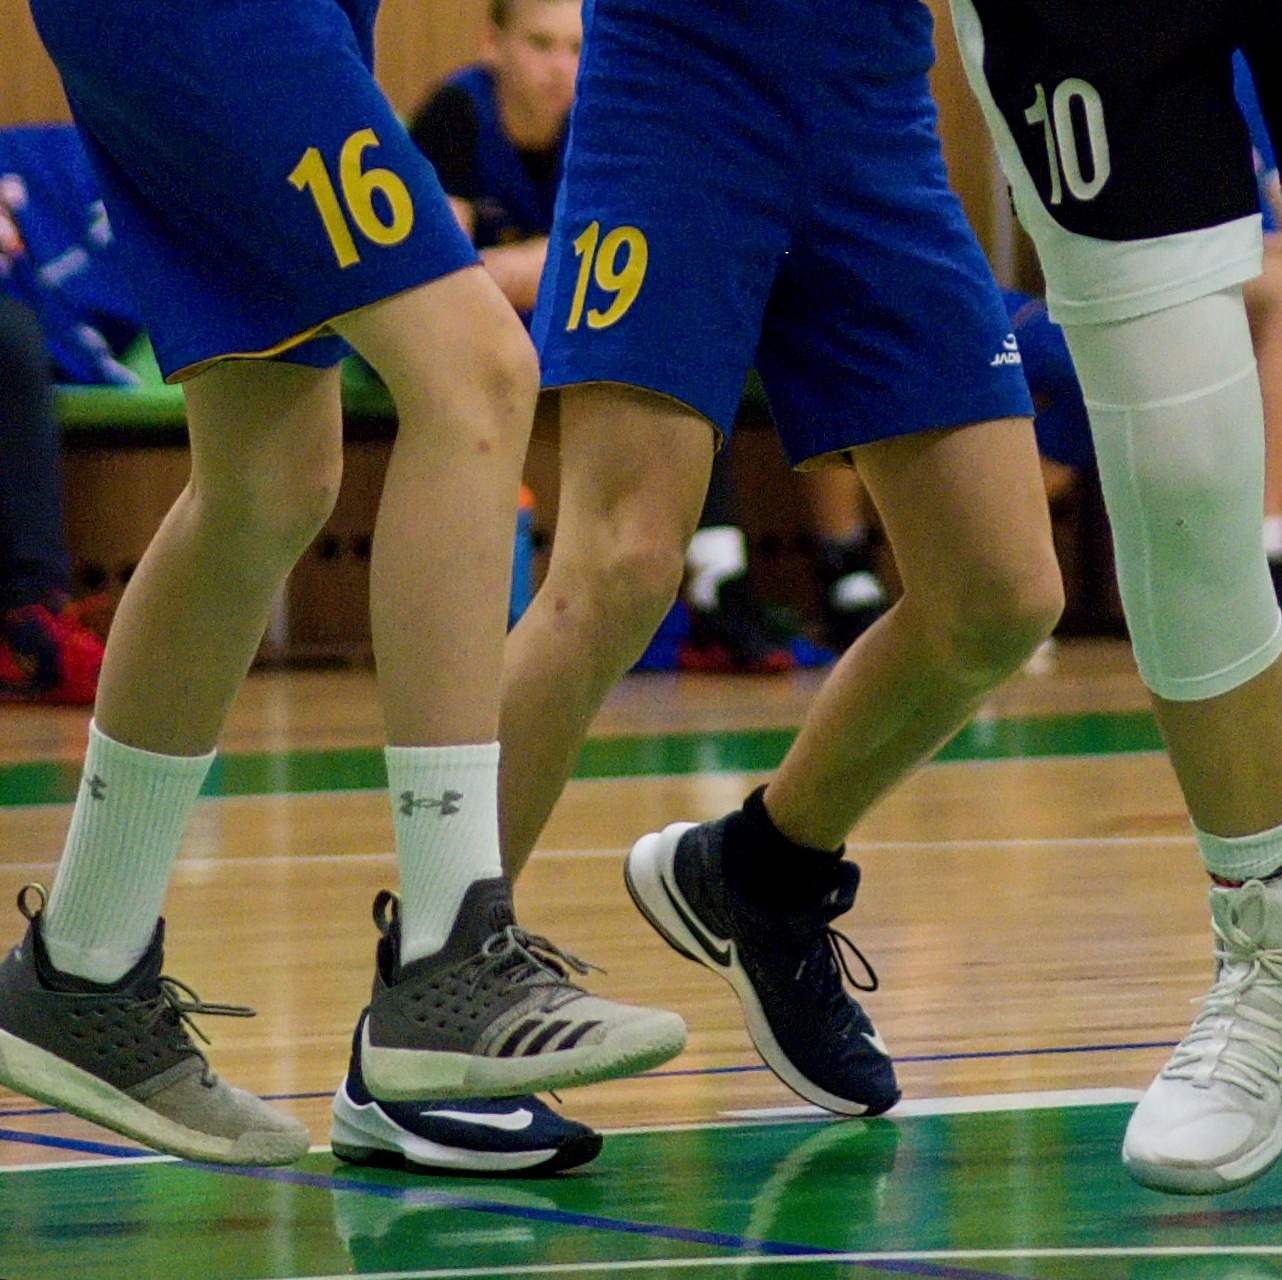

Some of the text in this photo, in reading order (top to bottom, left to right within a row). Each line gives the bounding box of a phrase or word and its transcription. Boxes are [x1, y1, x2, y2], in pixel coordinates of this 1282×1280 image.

[287, 127, 414, 270] 16
[1024, 77, 1111, 204] 10
[565, 220, 649, 332] 19
